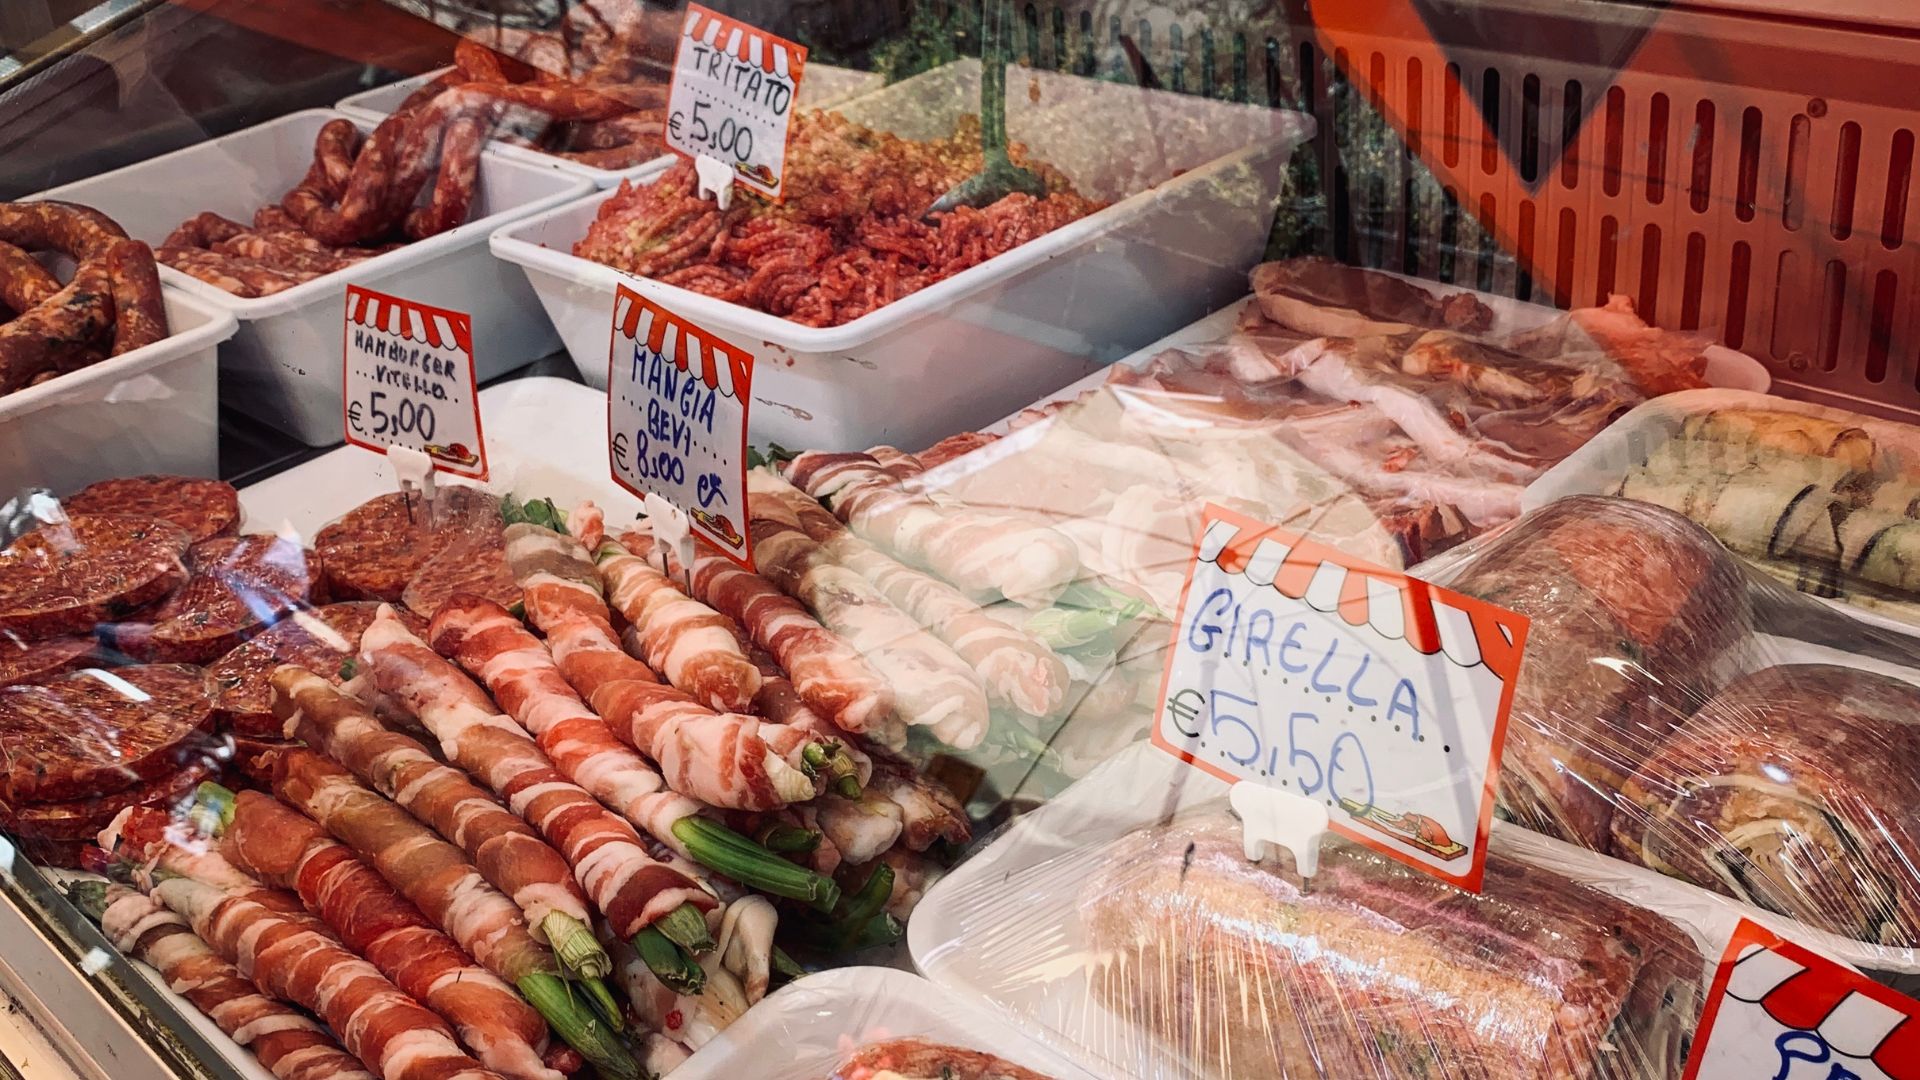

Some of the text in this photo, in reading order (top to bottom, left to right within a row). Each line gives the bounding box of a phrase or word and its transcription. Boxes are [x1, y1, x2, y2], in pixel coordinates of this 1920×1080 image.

[355, 330, 456, 382] HAMBURGER
[631, 344, 716, 433] MANGIA
[648, 397, 691, 457] BEVI
[1188, 588, 1418, 741] GIRELLA
